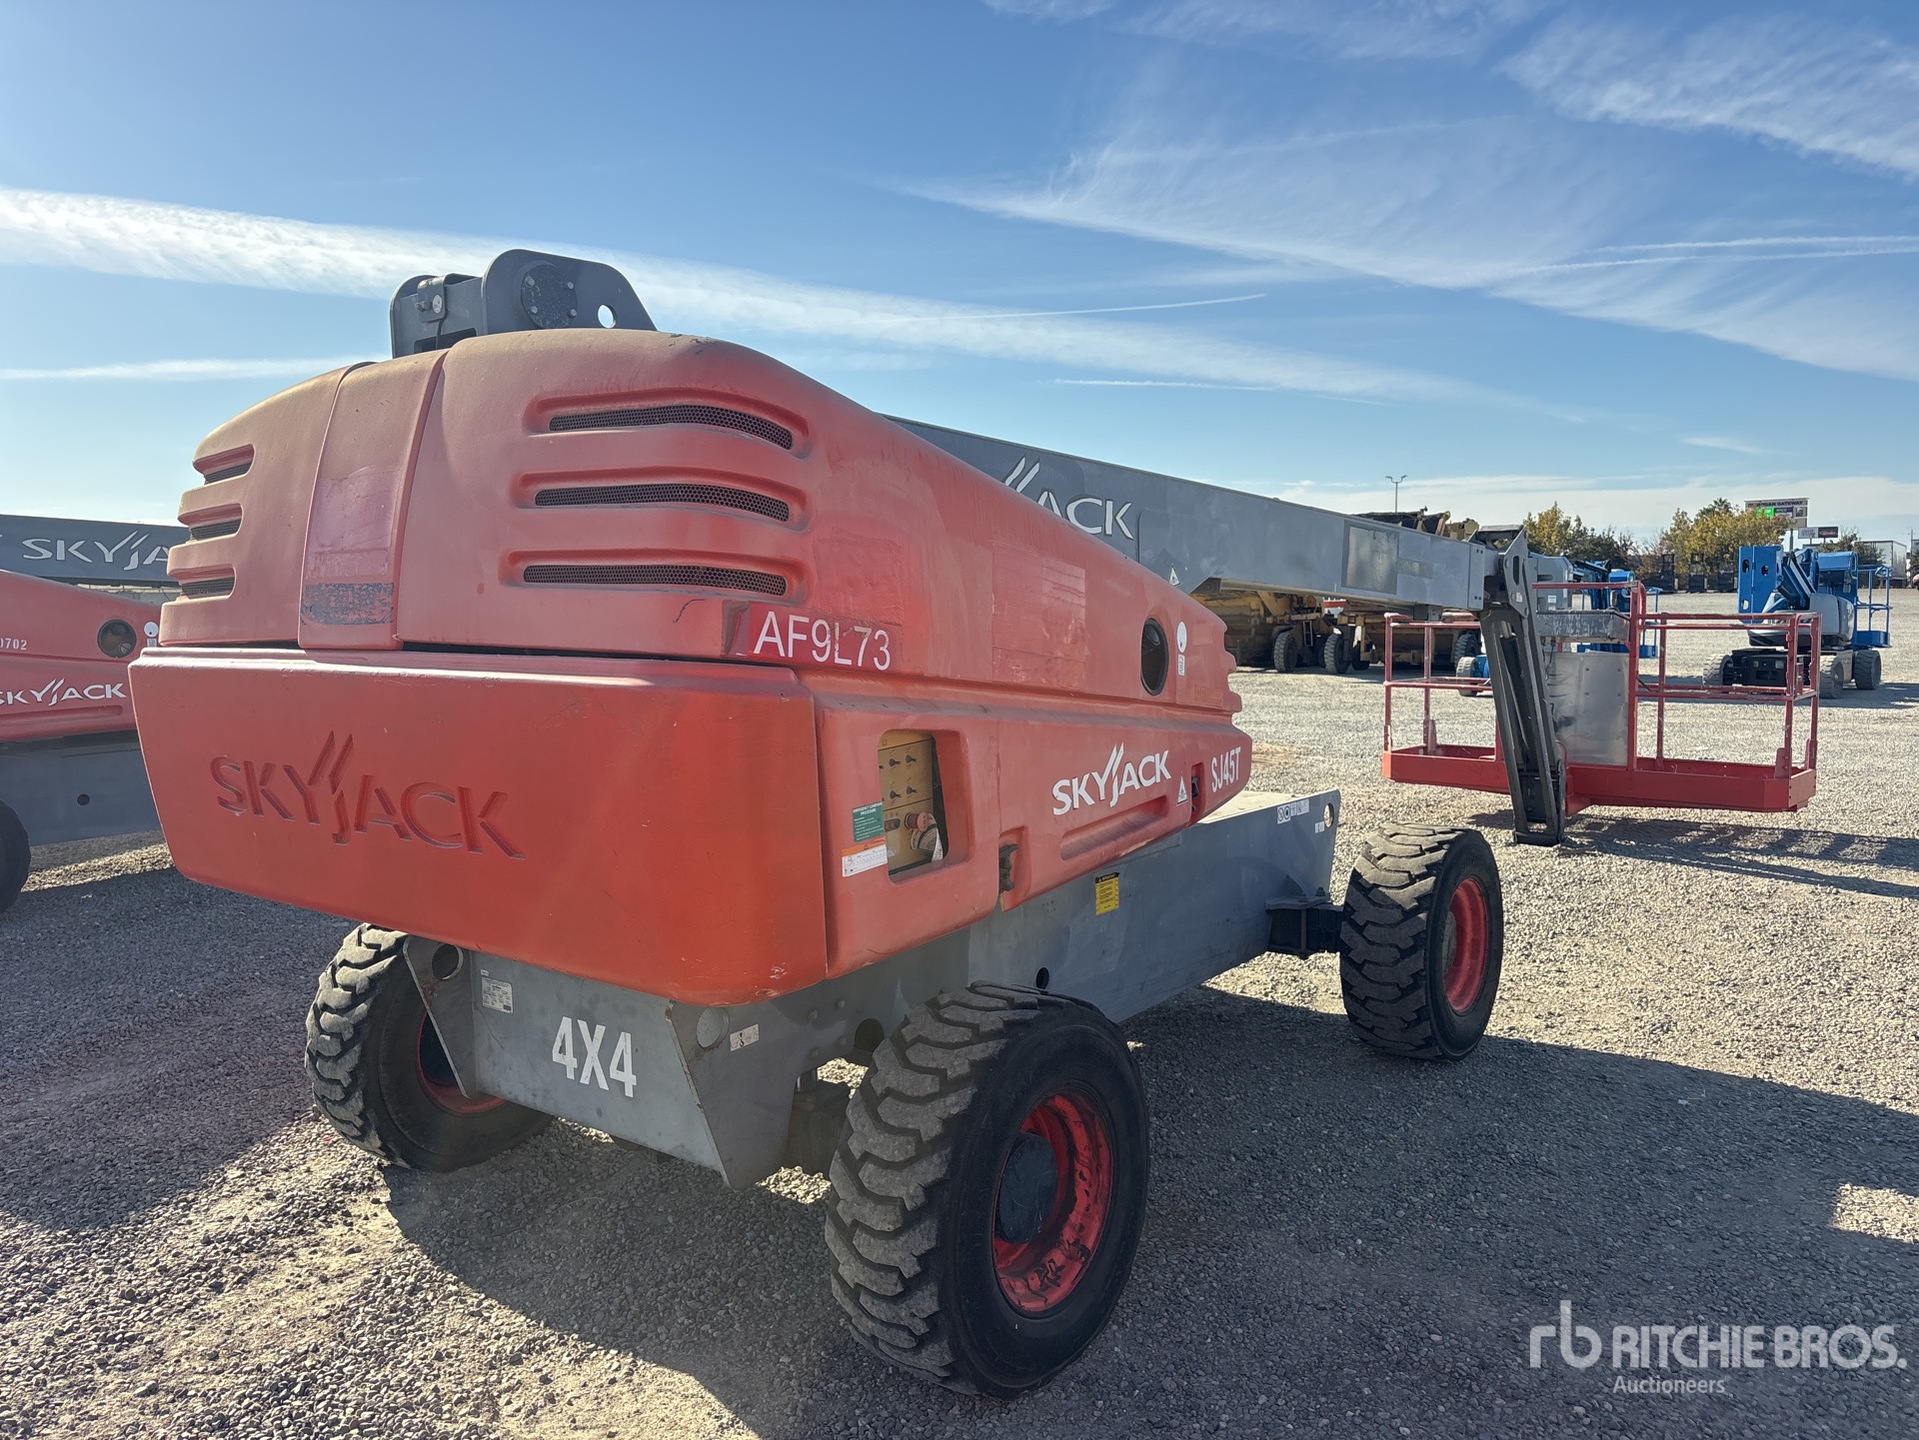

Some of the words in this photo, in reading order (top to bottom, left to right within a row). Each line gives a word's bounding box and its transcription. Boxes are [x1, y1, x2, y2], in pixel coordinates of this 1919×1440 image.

[22, 530, 170, 571] SKYJA
[753, 611, 891, 671] AF9L73
[210, 731, 526, 859] SKYJACK
[1052, 742, 1172, 816] SKYJACK
[1211, 746, 1242, 793] SJ45T
[552, 1016, 637, 1098] 4X4
